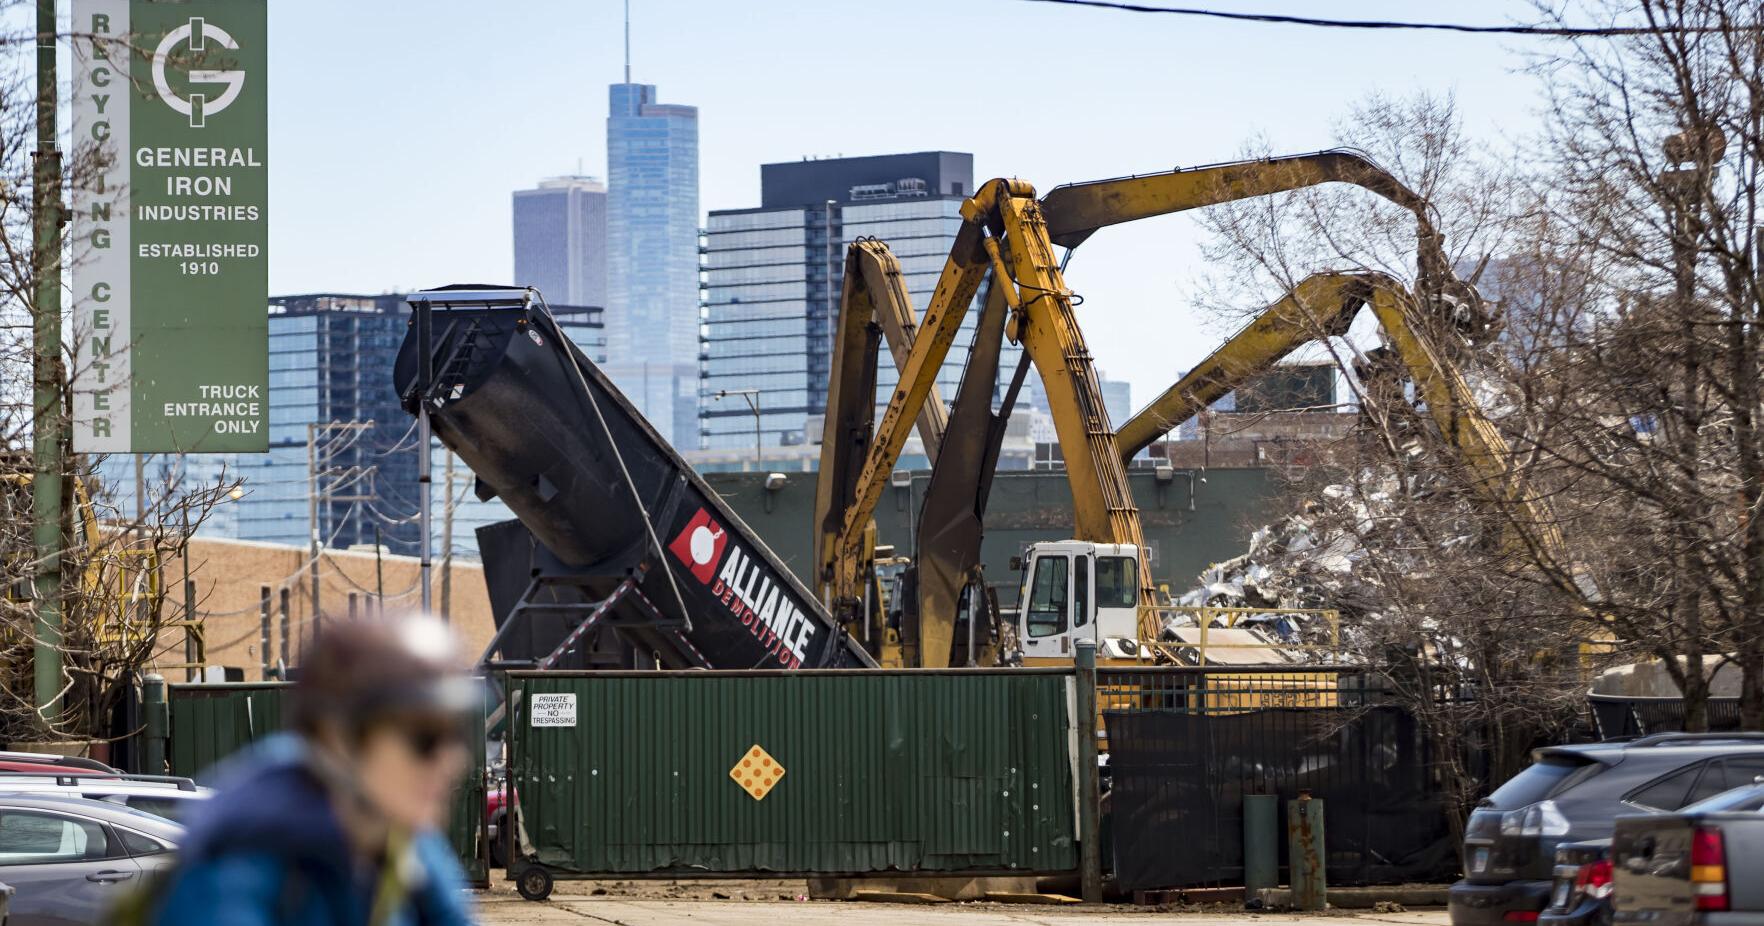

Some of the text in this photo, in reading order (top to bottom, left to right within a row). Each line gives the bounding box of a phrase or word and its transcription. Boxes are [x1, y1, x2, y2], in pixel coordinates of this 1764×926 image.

[136, 147, 261, 167] GENERAL
[167, 176, 231, 195] IRON
[138, 205, 259, 220] INDUSTRIES
[138, 244, 259, 257] ESTABLISHED
[180, 262, 219, 274] 1910
[91, 282, 112, 437] CENTER
[199, 386, 259, 398] TRUCK
[164, 404, 259, 416] ENTRANCE
[214, 421, 259, 434] ONLY
[719, 545, 816, 663] ALLIANCE
[711, 578, 800, 670] DEMOLITION
[538, 695, 569, 703] PRIVATE
